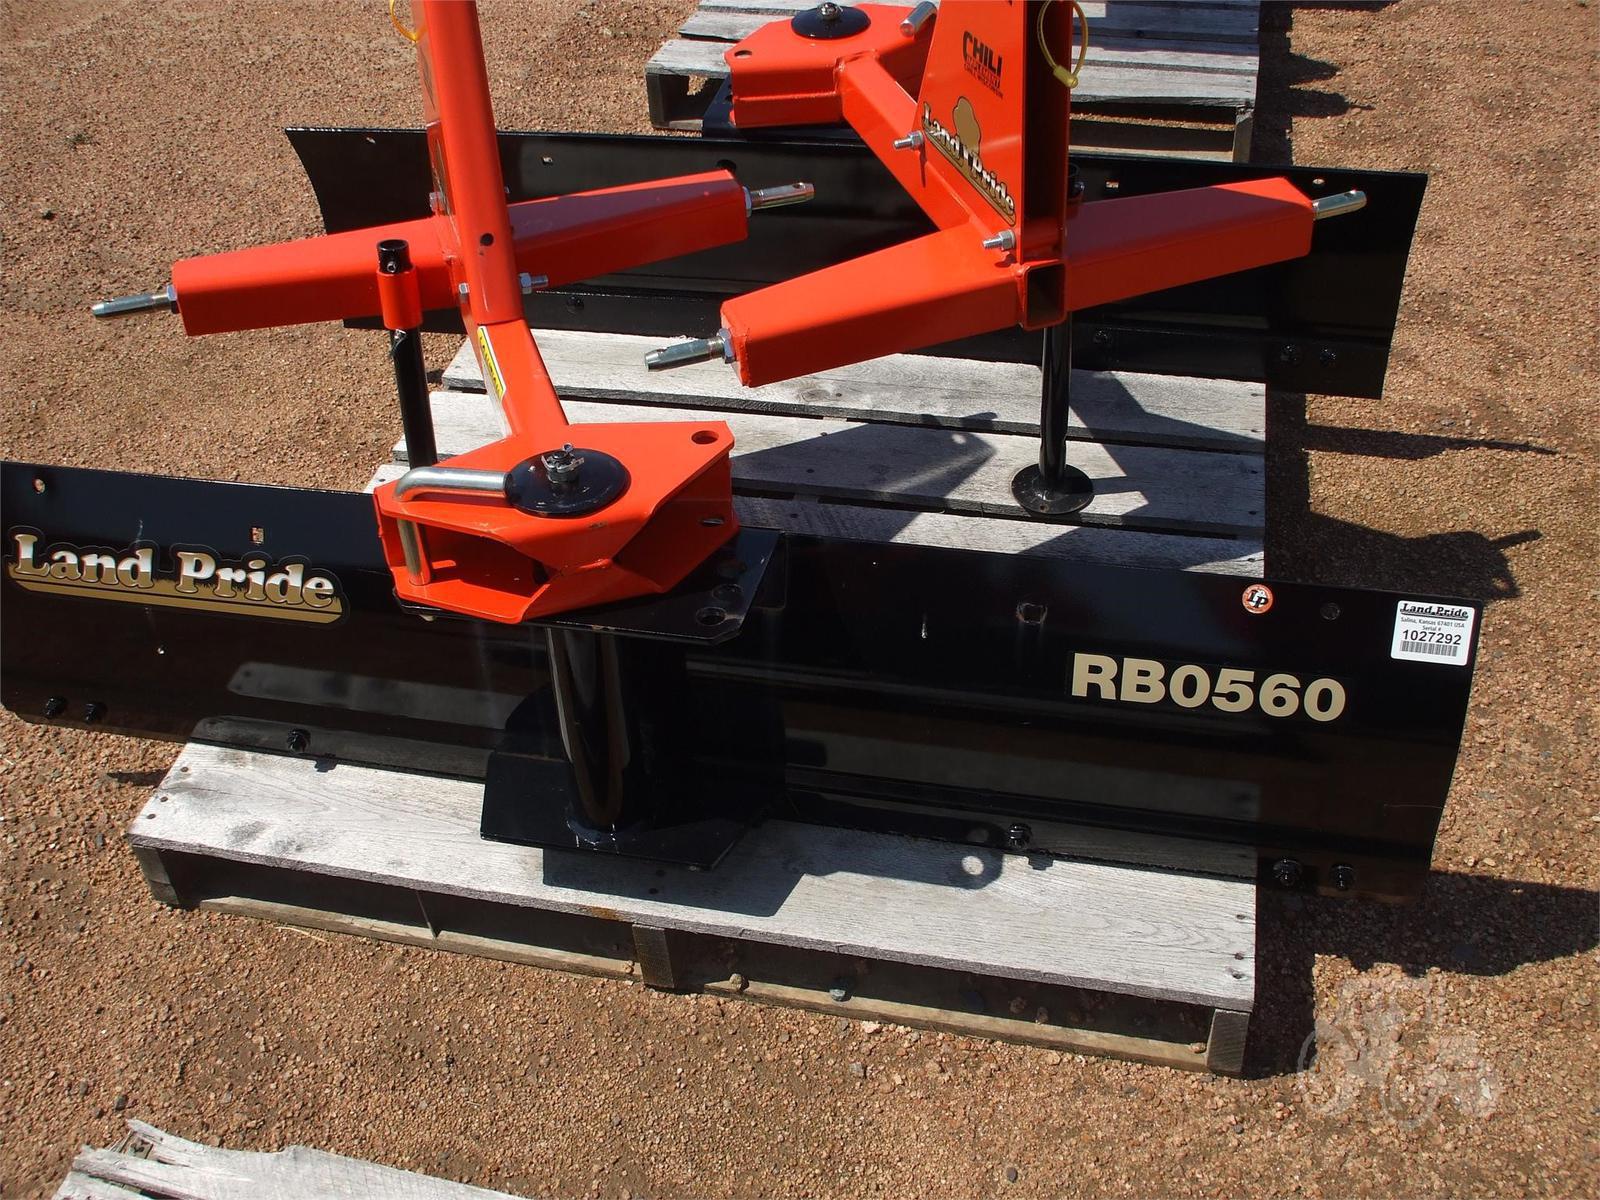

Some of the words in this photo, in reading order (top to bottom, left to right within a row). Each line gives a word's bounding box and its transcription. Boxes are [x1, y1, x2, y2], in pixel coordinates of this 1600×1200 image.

[963, 31, 1002, 77] CHILI
[924, 102, 961, 160] Land
[970, 150, 1015, 214] Pride
[14, 534, 154, 587] Land
[175, 551, 334, 607] Pride
[1402, 603, 1433, 614] Land
[1436, 606, 1468, 618] Pride
[1402, 629, 1462, 645] 1027292
[1071, 652, 1346, 722] RB0560
